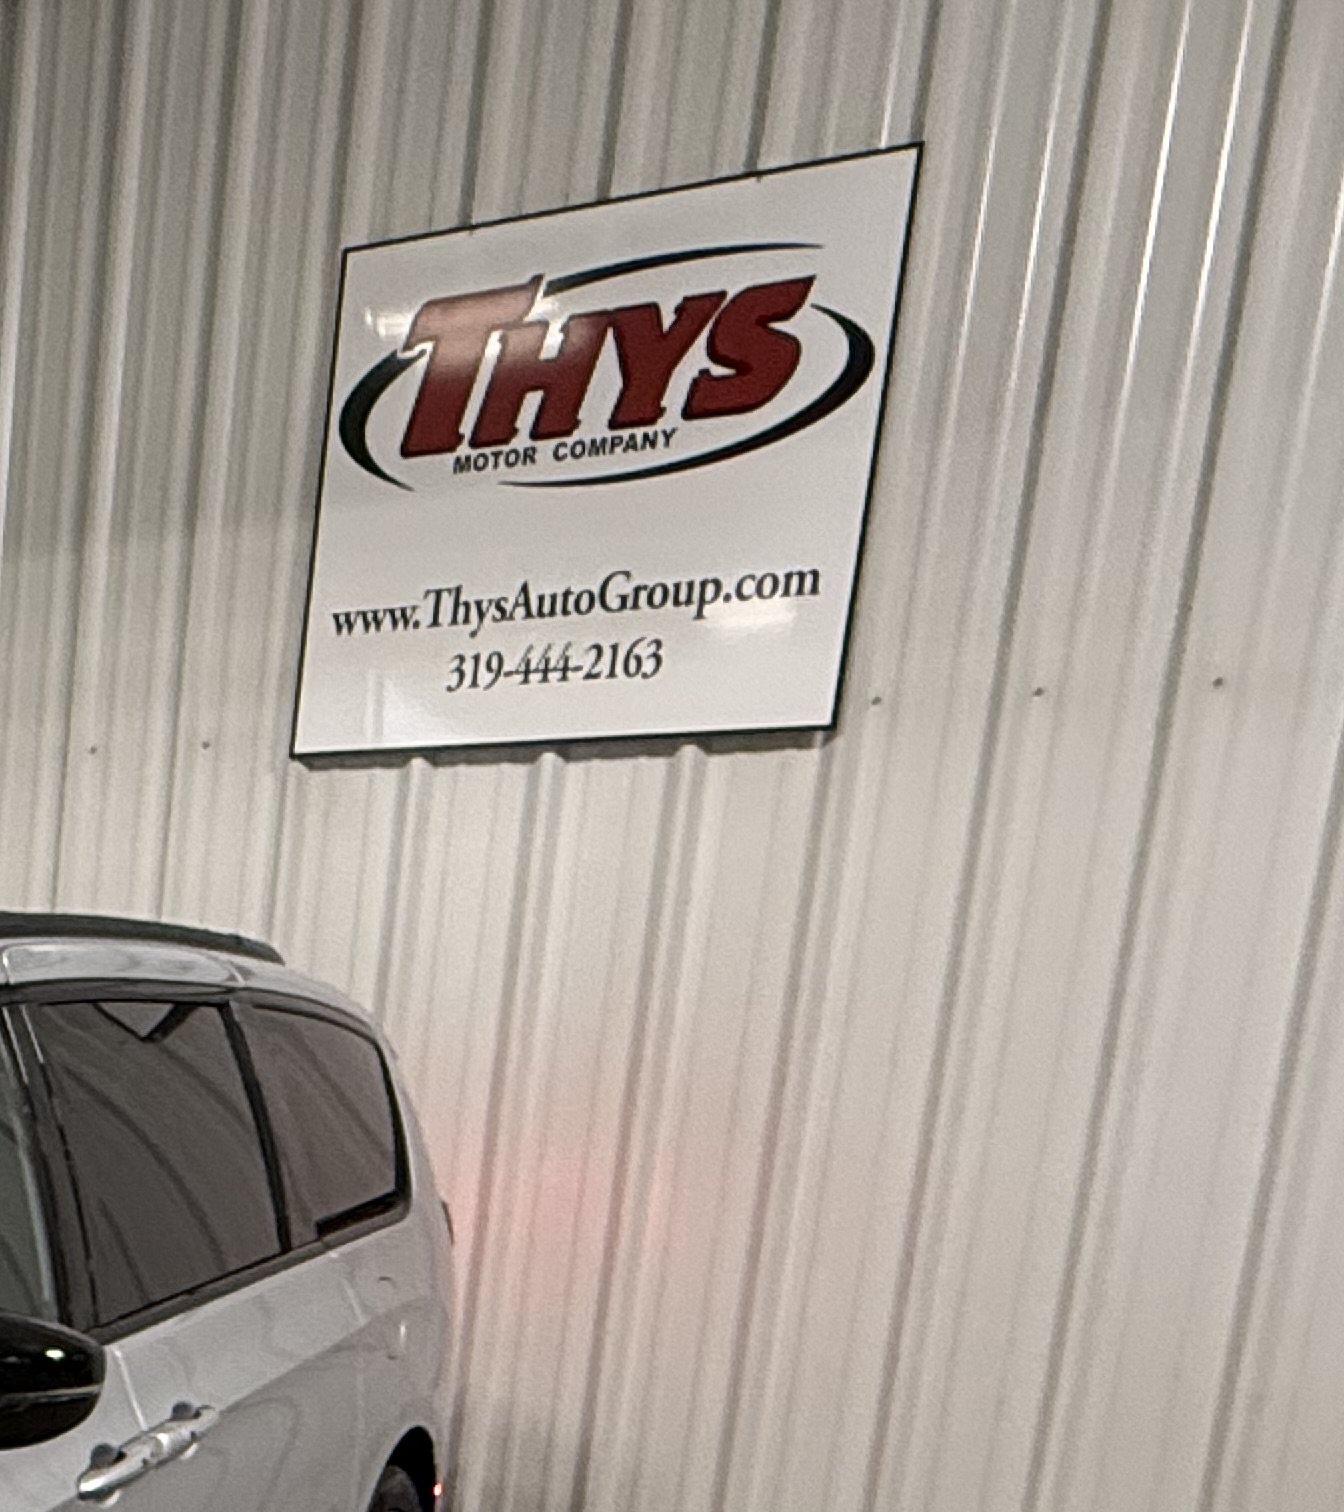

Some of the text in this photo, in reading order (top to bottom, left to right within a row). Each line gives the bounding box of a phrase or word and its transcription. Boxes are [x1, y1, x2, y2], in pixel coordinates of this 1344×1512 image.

[397, 273, 817, 458] THYS
[452, 427, 678, 475] MOTOR COMPANY
[331, 567, 822, 638] www.ThysAutoGroup.com
[445, 636, 664, 693] 319-444-2163
